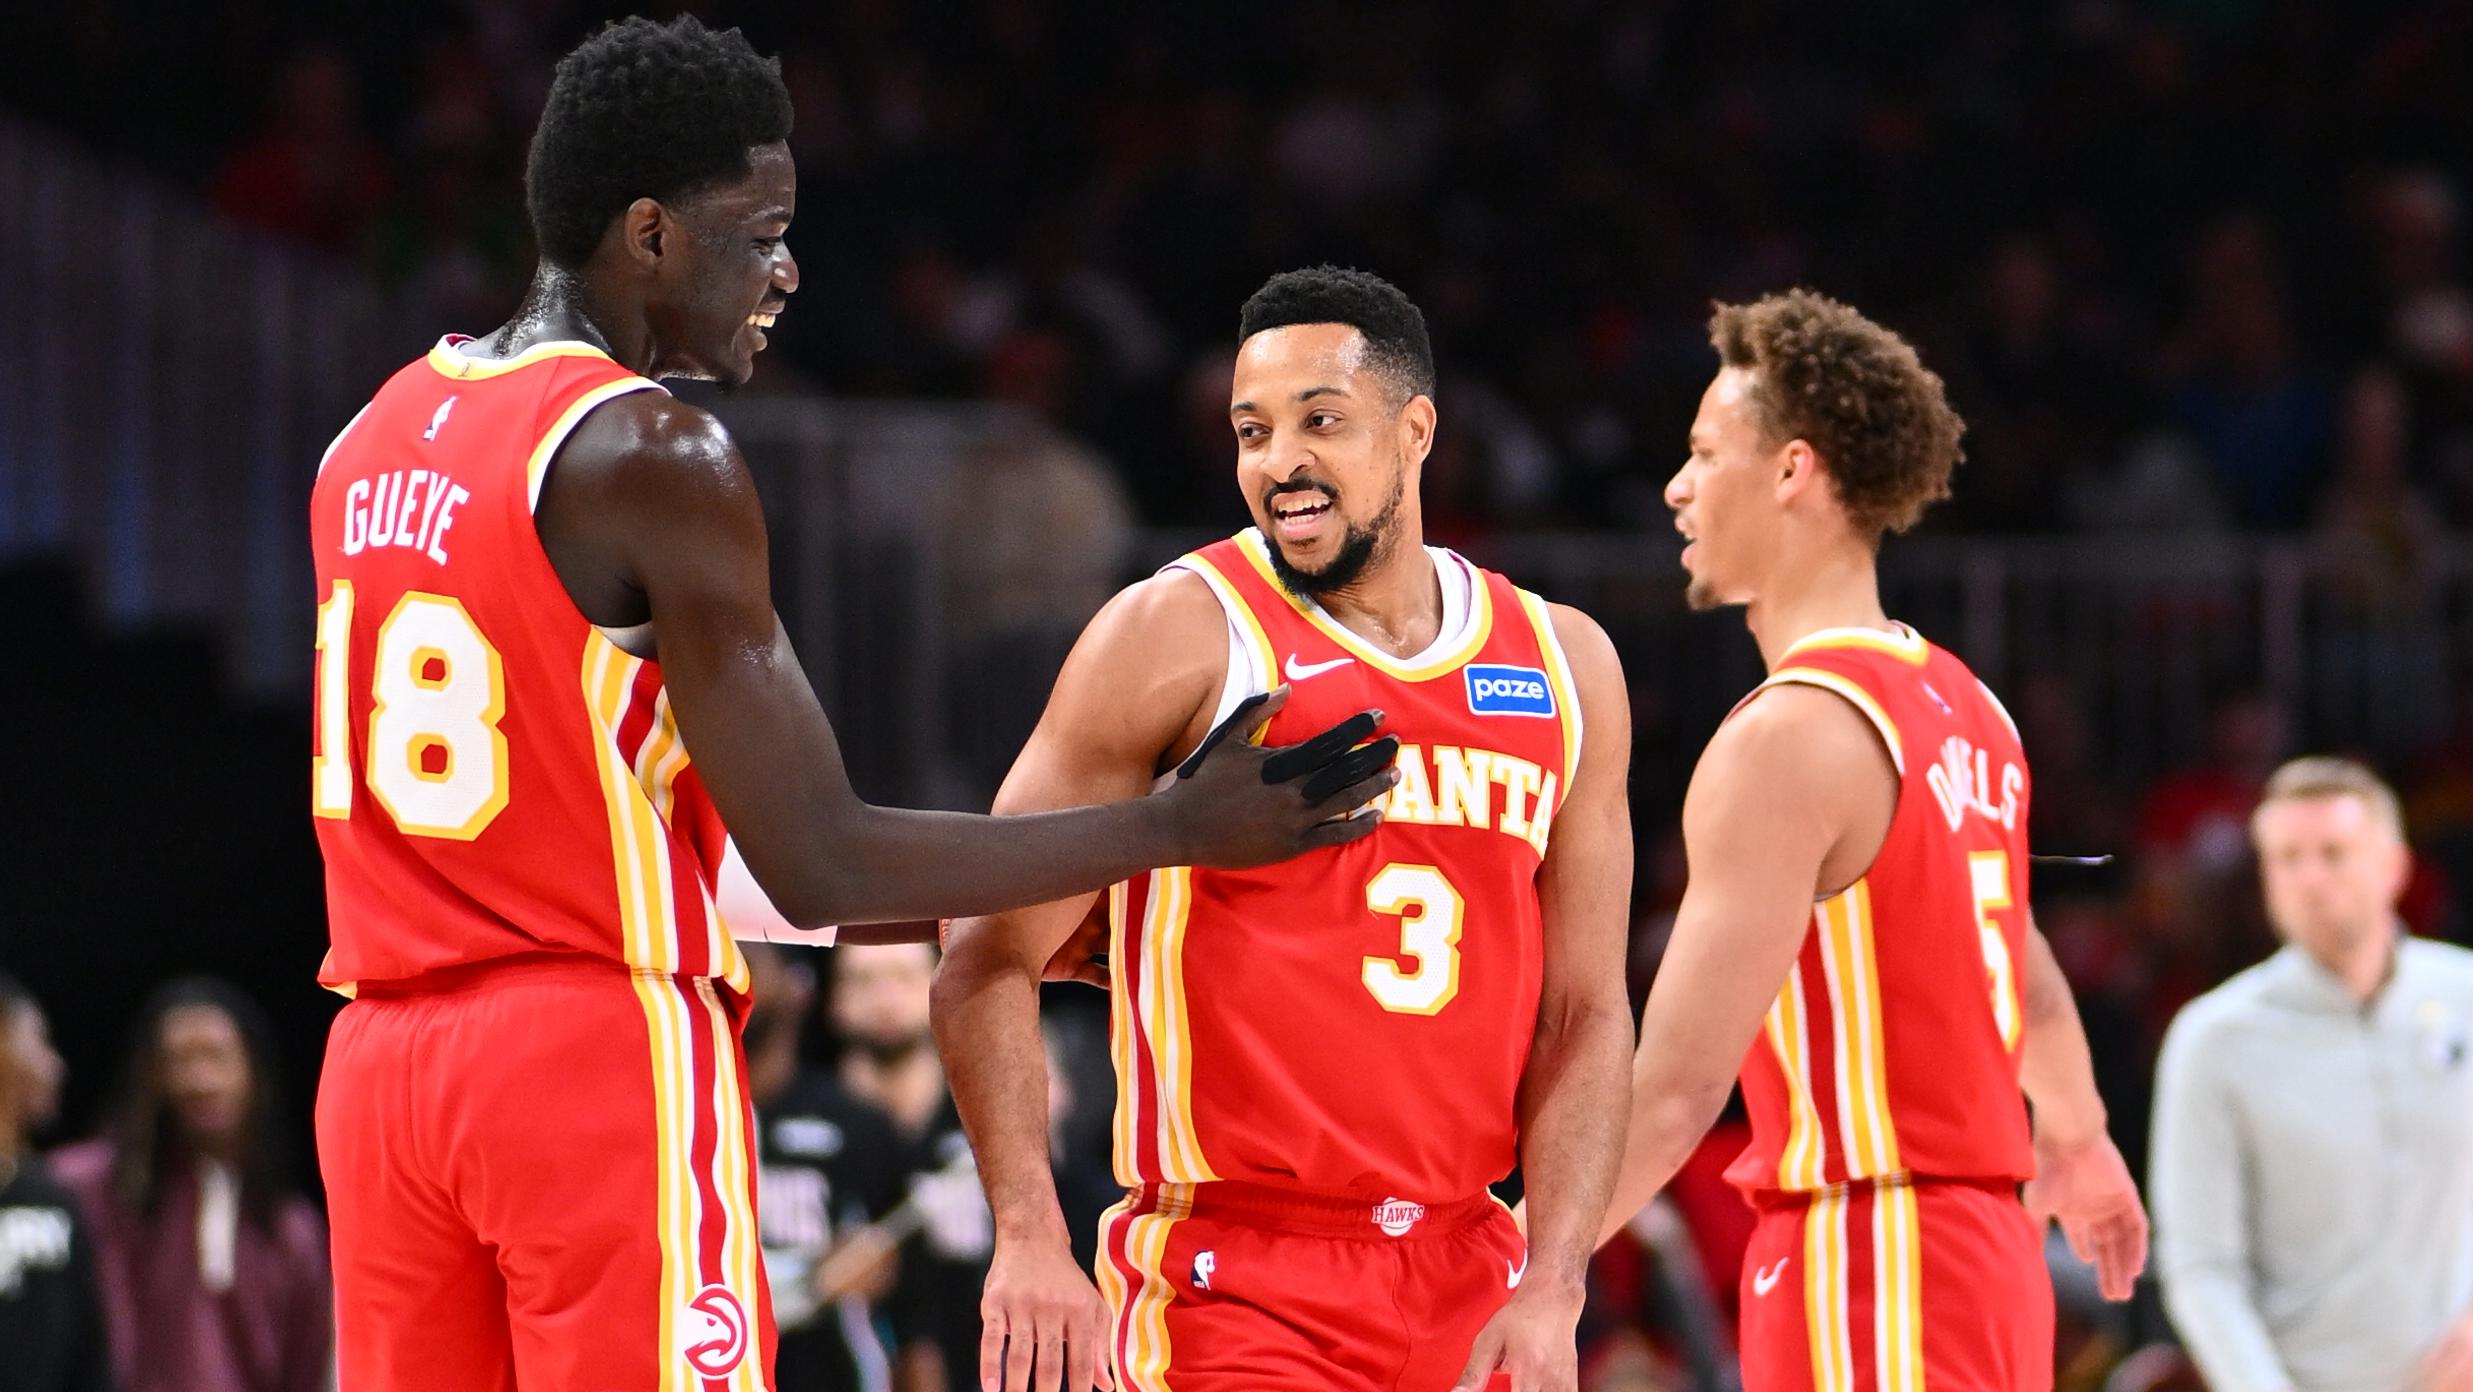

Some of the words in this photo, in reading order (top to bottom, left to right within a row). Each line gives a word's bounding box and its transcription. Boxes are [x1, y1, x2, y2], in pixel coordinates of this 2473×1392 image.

[344, 470, 469, 566] GUEYE
[313, 579, 510, 841] 18
[1474, 678, 1545, 702] paze
[1330, 743, 1557, 861] ANTA
[1362, 862, 1465, 1017] 3
[1968, 849, 2022, 1054] 5
[1373, 1205, 1425, 1223] HAWKS
